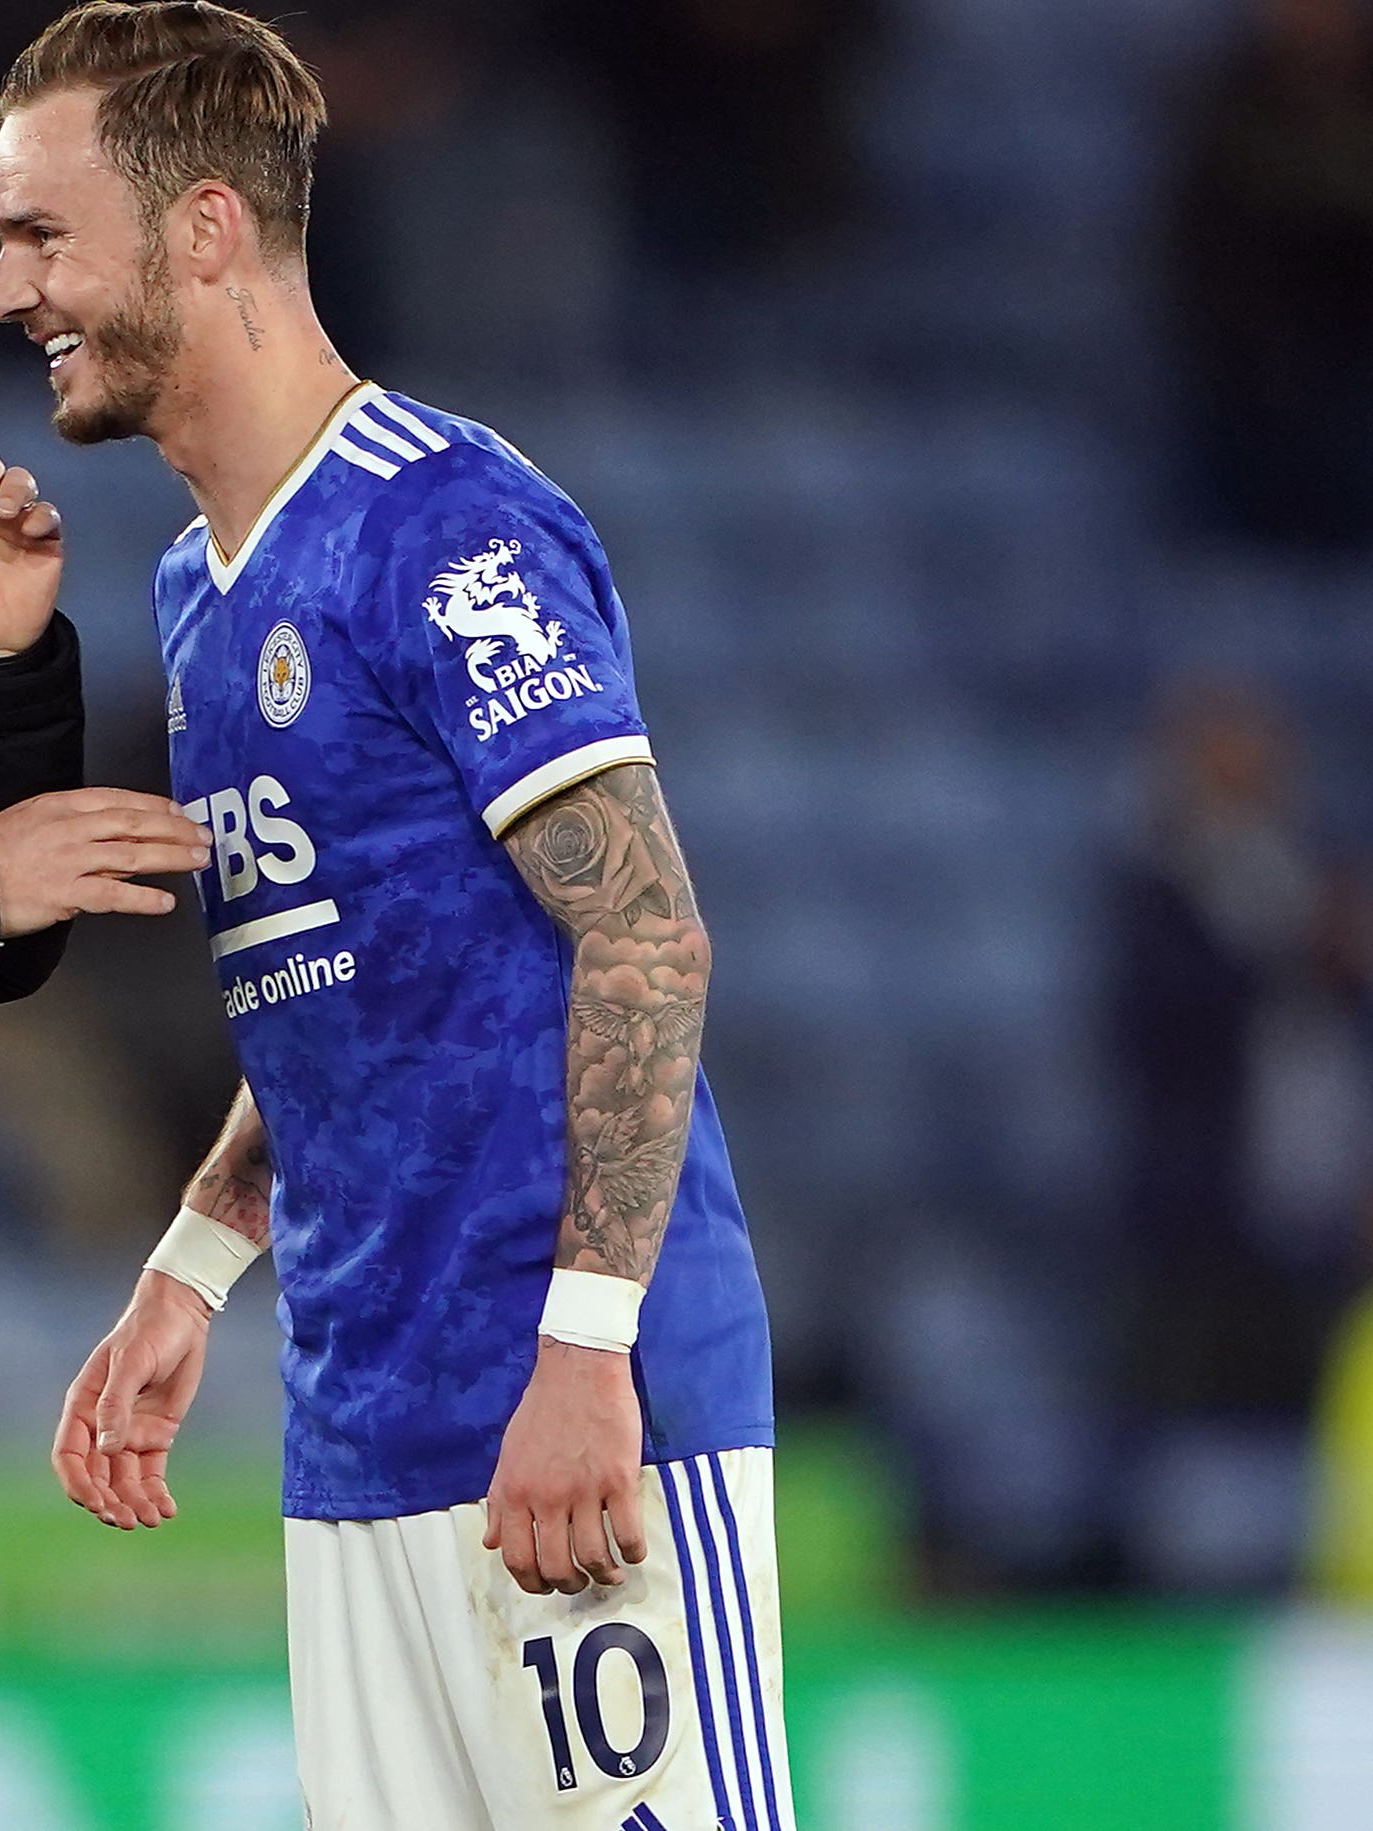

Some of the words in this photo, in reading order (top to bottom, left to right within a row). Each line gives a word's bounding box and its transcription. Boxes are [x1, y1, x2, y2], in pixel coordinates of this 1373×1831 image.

[469, 664, 599, 742] SAIGON
[493, 655, 542, 689] BIA
[222, 976, 259, 1019] ade
[260, 951, 356, 1004] online
[522, 1622, 670, 1791] 10
